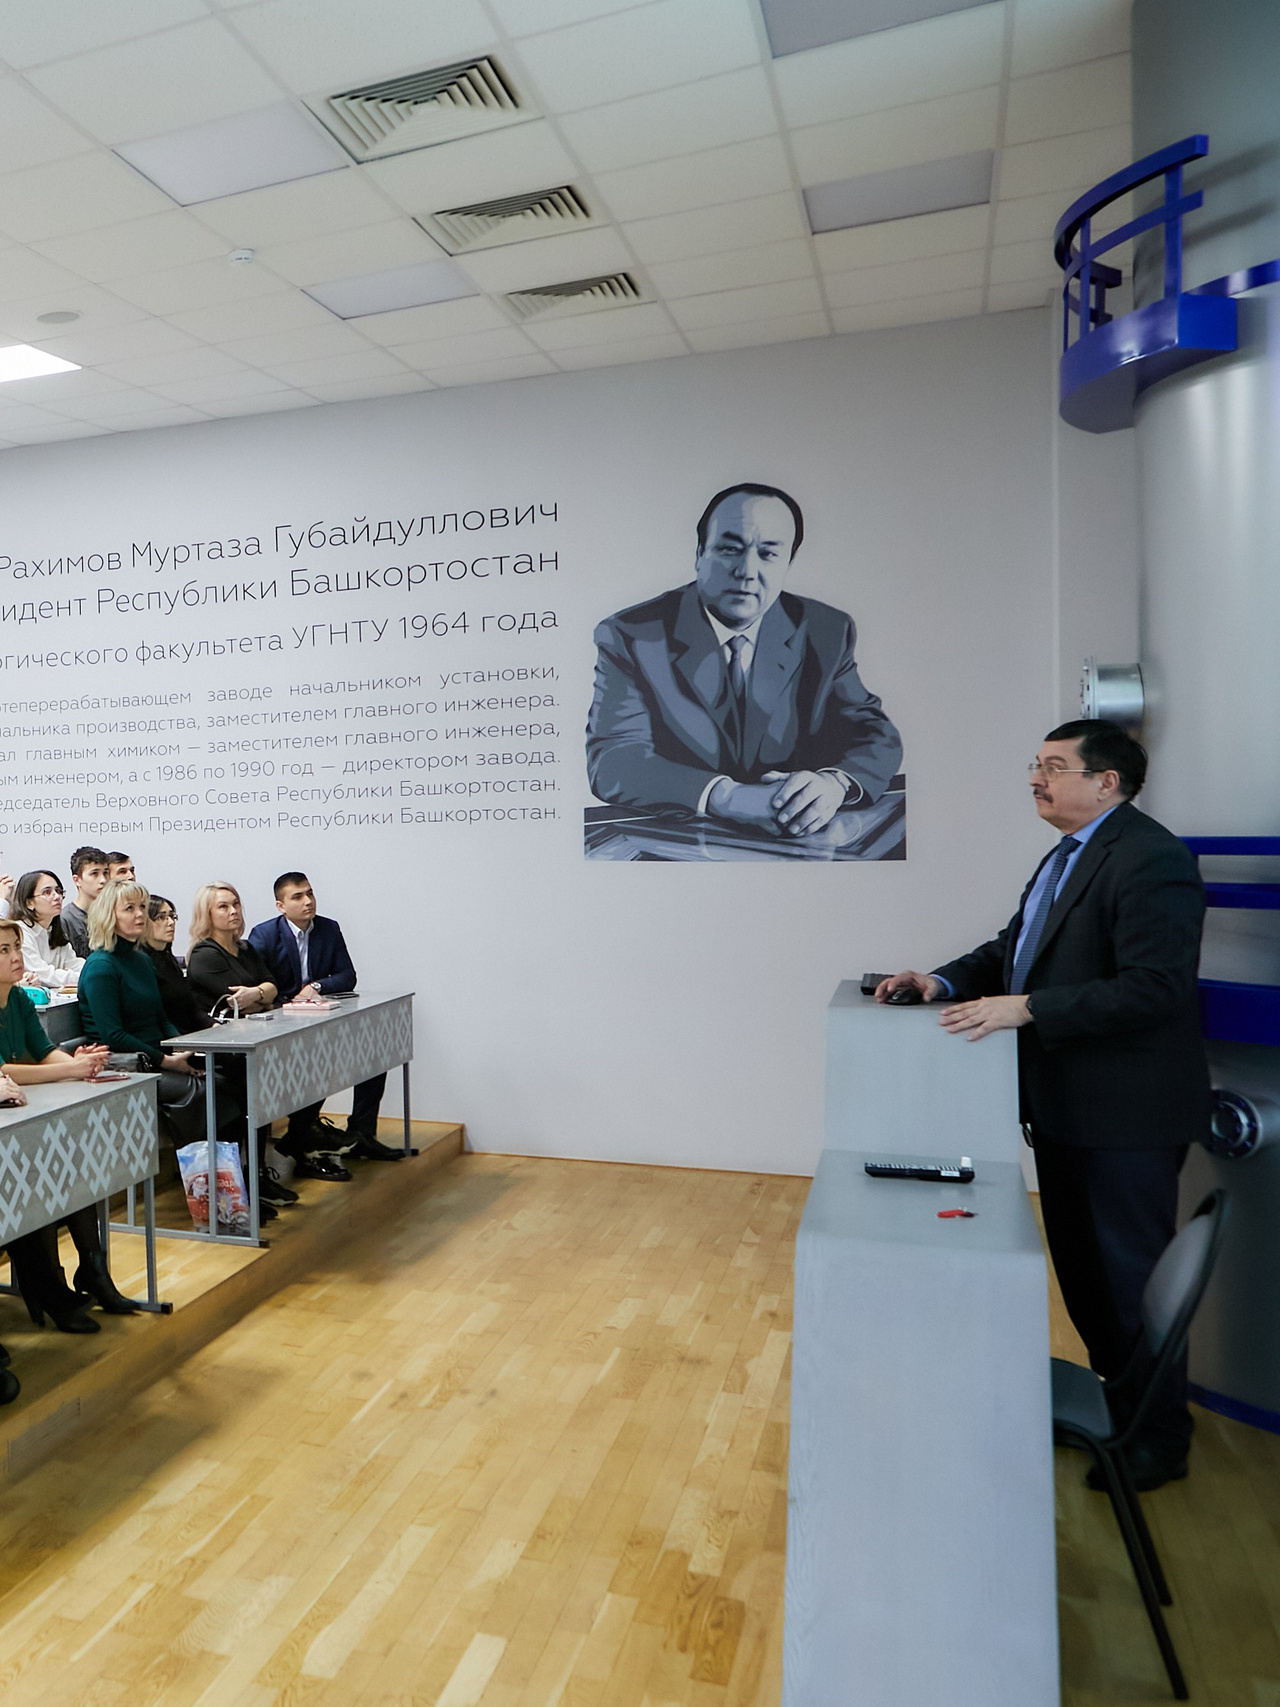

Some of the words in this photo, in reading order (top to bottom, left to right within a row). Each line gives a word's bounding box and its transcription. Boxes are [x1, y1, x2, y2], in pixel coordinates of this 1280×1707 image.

[131, 536, 264, 574] Муртаза
[274, 501, 558, 559] Губайдуллович
[97, 579, 277, 616] Республики
[290, 550, 559, 597] Башкортостан
[135, 634, 285, 667] факультета
[291, 617, 390, 650] УГНТУ
[398, 610, 471, 640] 1964
[481, 610, 560, 636] года
[207, 686, 273, 703] заводе
[289, 675, 422, 697] начальником
[439, 666, 560, 691] установки,
[76, 717, 201, 739] производства,
[206, 708, 338, 728] заместителем
[341, 701, 438, 720] главного
[444, 694, 560, 713] инженера.
[25, 747, 97, 761] главным
[107, 743, 181, 759] химиком
[207, 735, 338, 754] заместителем
[344, 728, 439, 747] главного
[444, 722, 561, 741] инженера,
[23, 771, 124, 788] инженером,
[128, 770, 139, 783] а
[142, 770, 152, 782] с
[155, 763, 198, 782] 1986
[203, 766, 226, 780] по
[230, 760, 276, 778] 1990
[281, 762, 315, 778] год
[341, 754, 468, 776] директором
[475, 750, 561, 768] завода.
[95, 792, 200, 812] Верховного
[204, 788, 271, 806] Совета
[276, 782, 393, 805] Республики
[399, 778, 561, 798] Башкортостан.
[13, 818, 74, 838] избран
[78, 821, 144, 837] первым
[146, 816, 271, 836] Президентом
[277, 809, 394, 831] Республики
[397, 806, 562, 826] Башкортостан.
